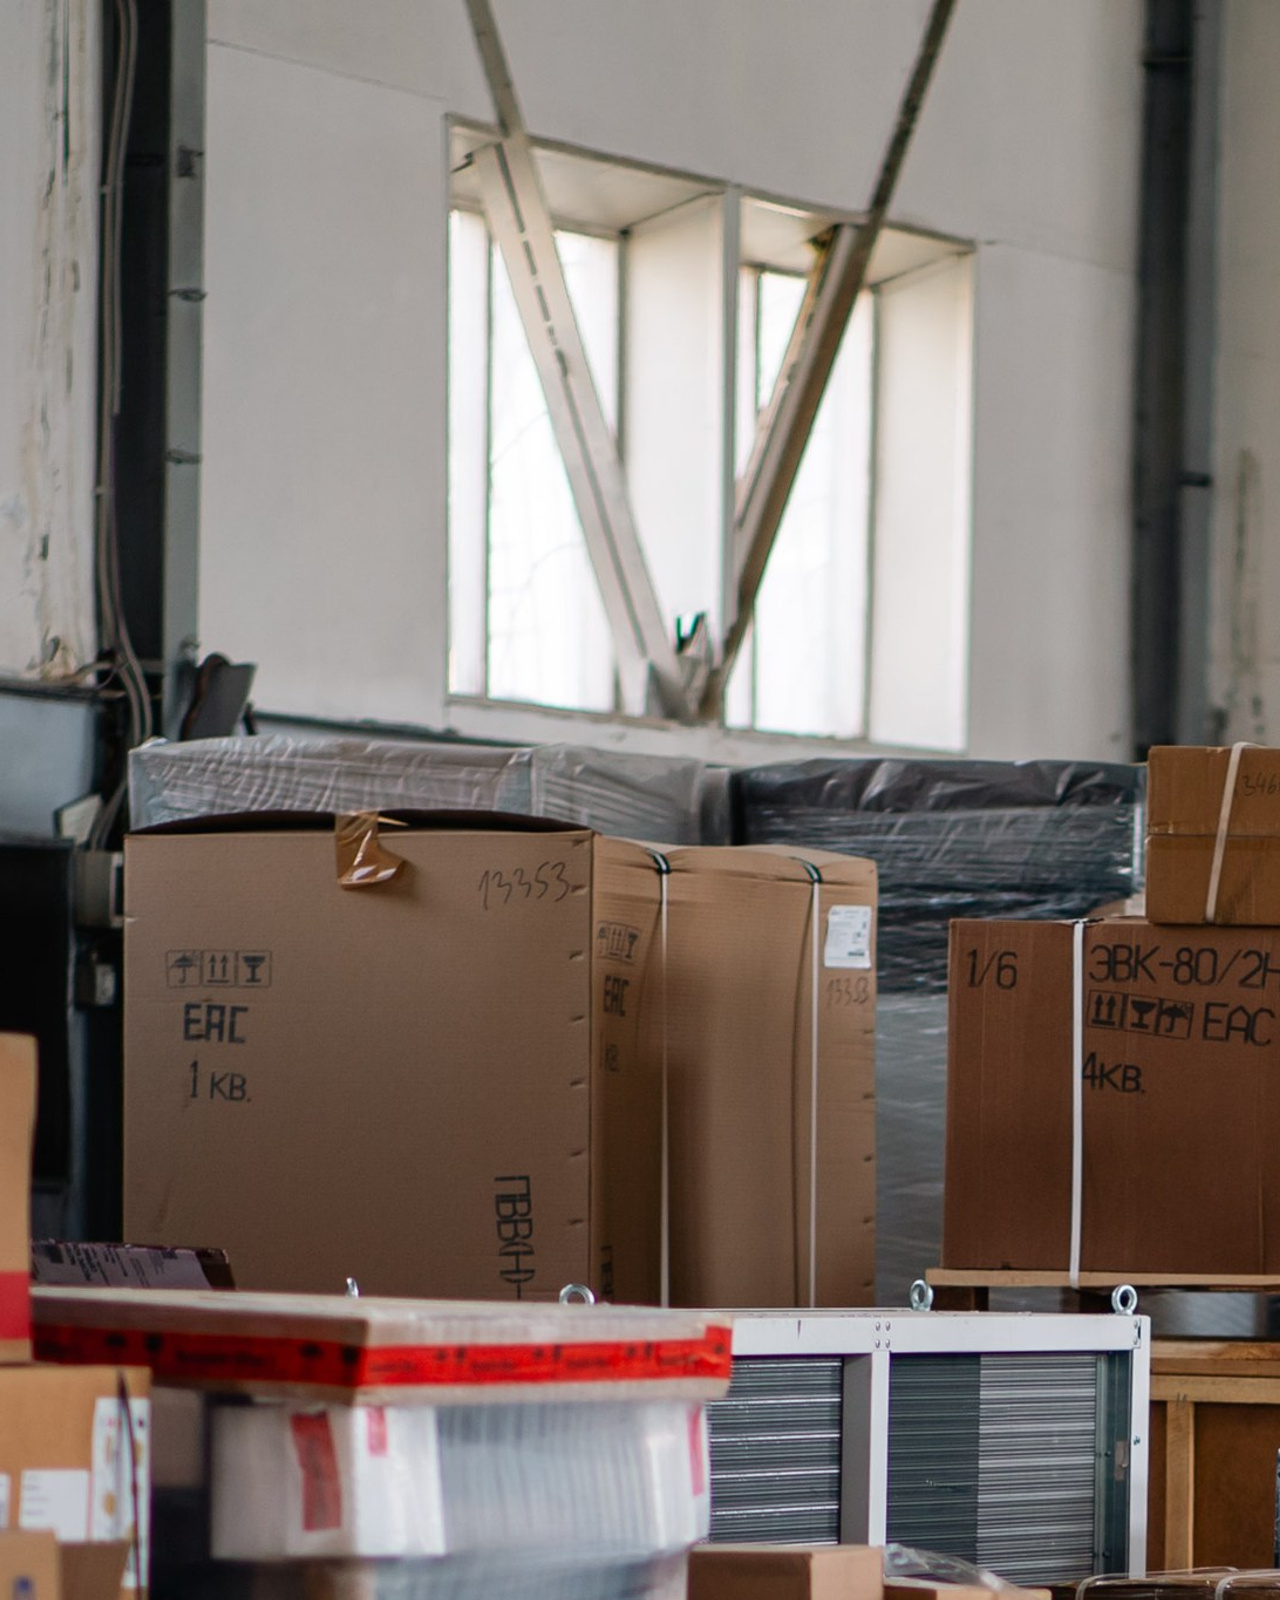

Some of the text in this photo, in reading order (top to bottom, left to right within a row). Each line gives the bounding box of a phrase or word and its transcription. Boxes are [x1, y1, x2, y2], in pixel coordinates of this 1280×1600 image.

[967, 949, 1018, 990] 1/6
[183, 1002, 249, 1043] EAC
[1202, 1002, 1276, 1046] EAC
